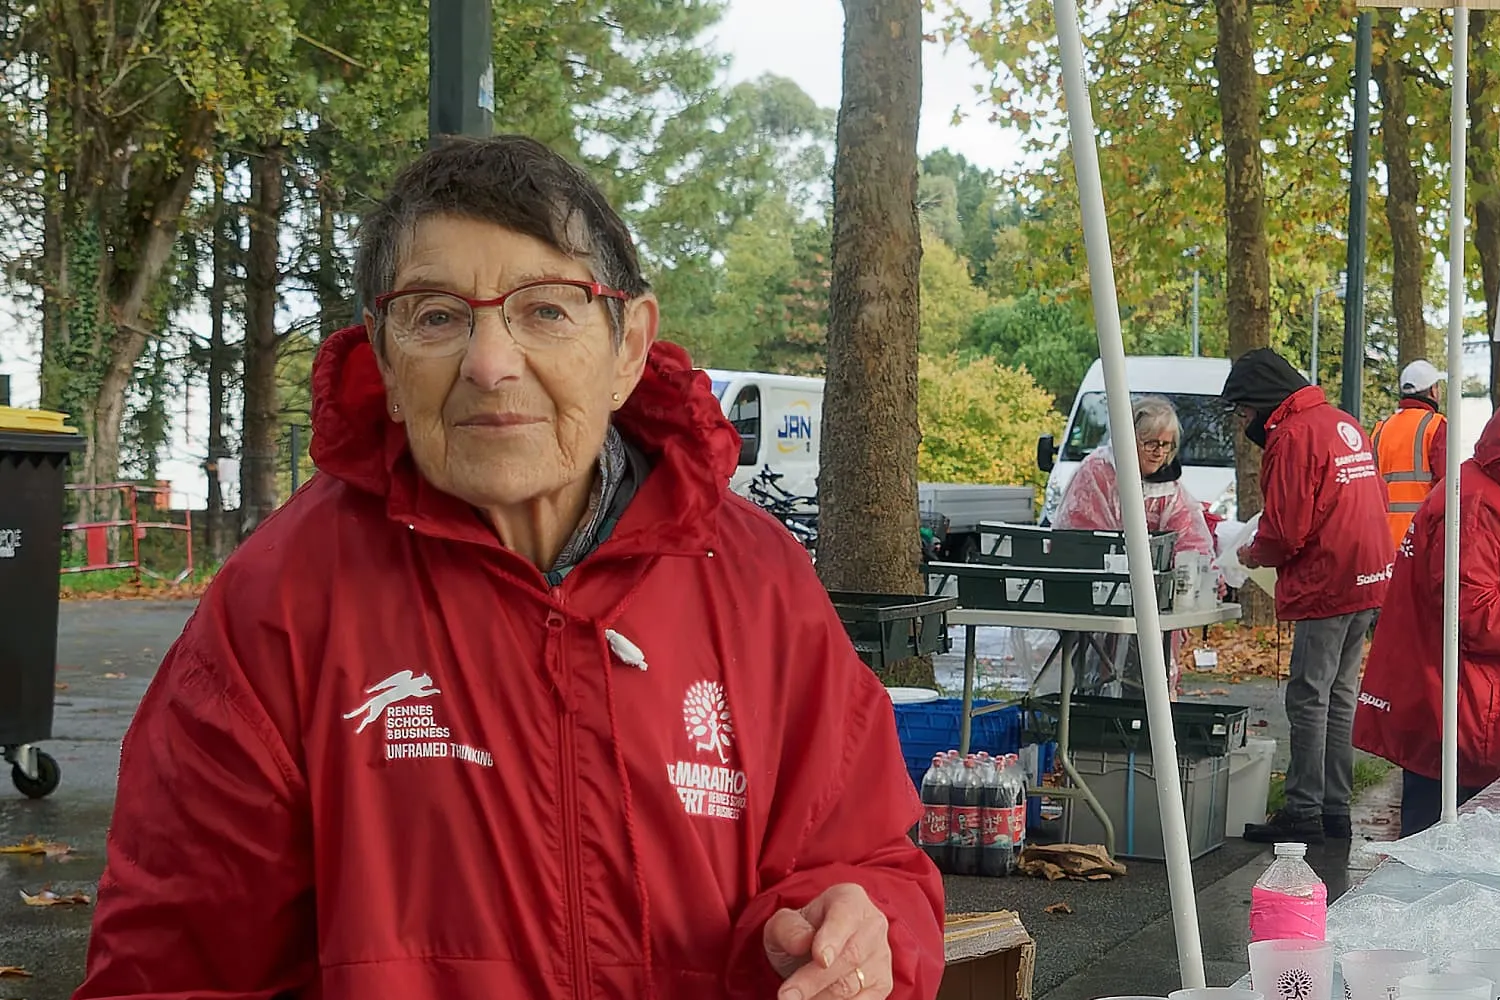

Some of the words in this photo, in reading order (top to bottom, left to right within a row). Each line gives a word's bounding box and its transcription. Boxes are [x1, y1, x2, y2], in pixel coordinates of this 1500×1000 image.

[386, 705, 433, 717] RENNES
[386, 717, 437, 729] SCHOOL
[394, 727, 450, 740] BUSINESS
[386, 742, 448, 760] UNFRAMED
[676, 761, 747, 795] MARATHO
